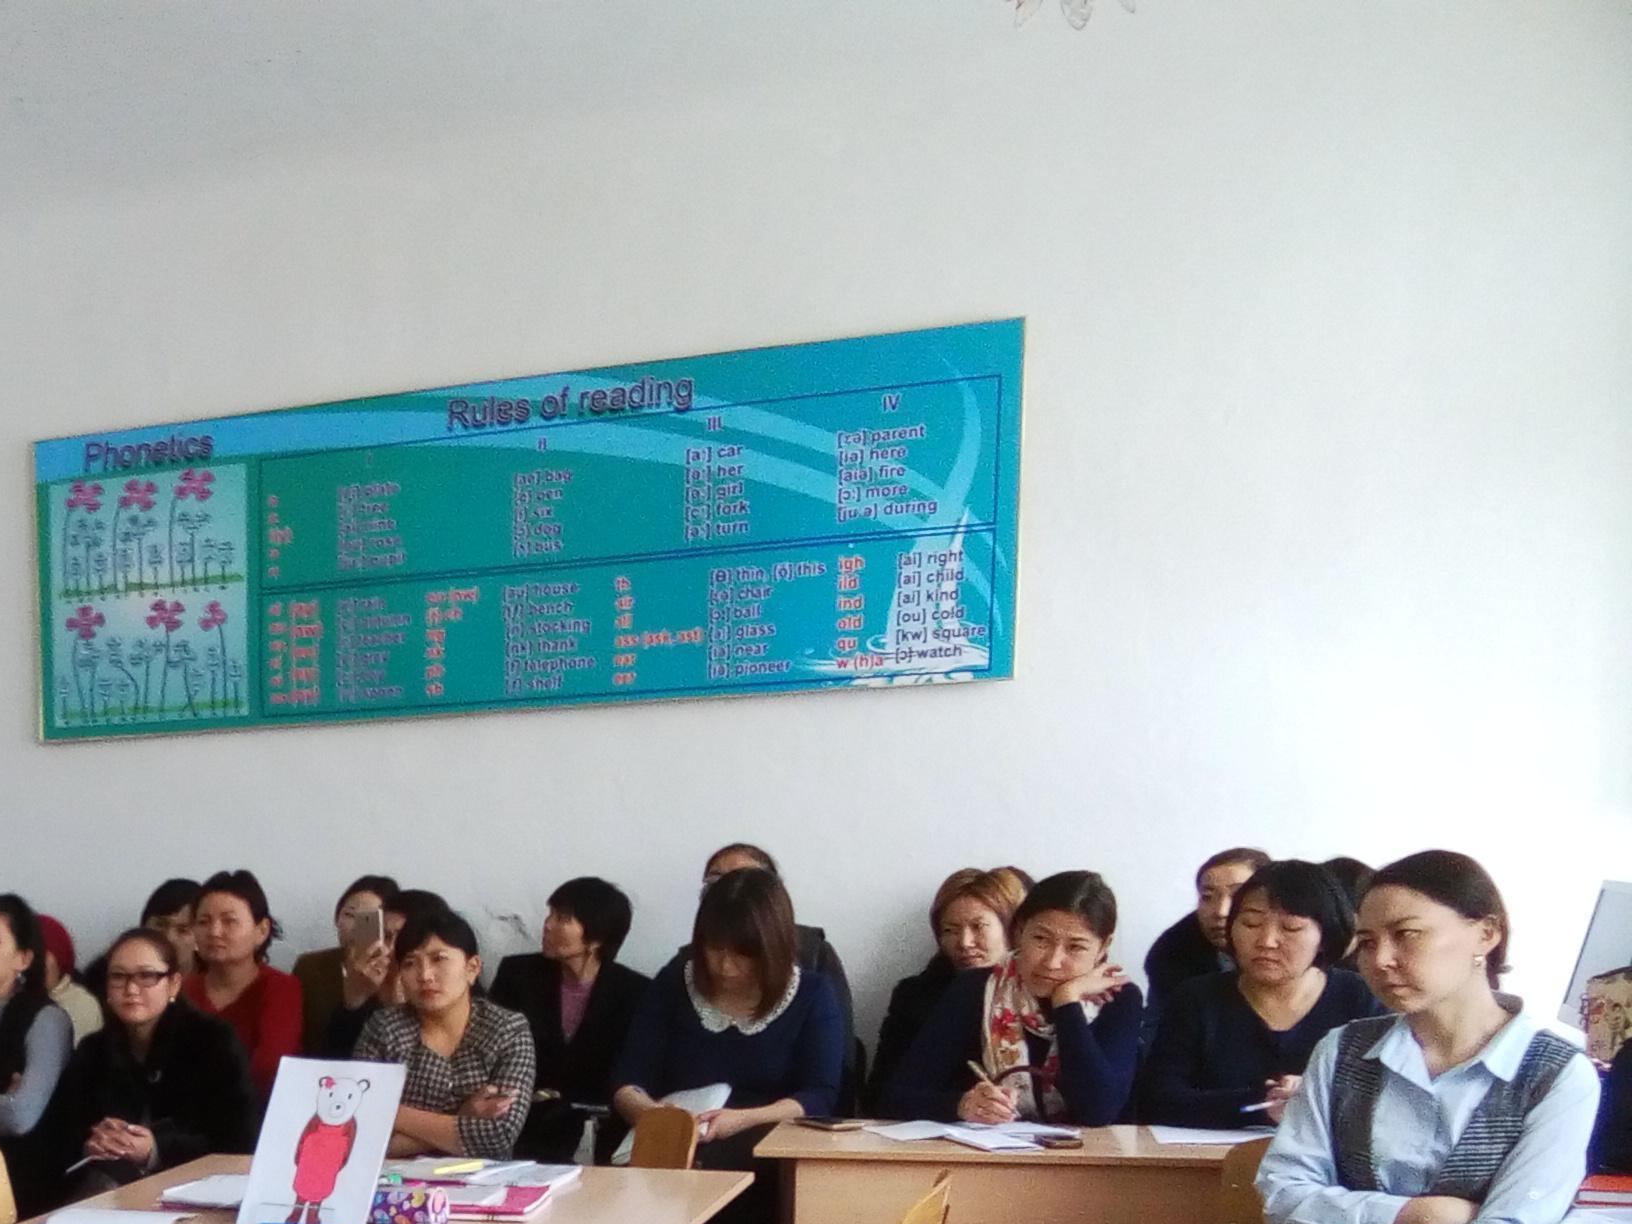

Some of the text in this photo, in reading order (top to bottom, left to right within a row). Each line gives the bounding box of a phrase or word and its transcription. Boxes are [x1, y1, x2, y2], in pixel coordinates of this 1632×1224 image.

[447, 375, 694, 431] Rules of reading
[882, 395, 901, 411] IV
[707, 416, 722, 431] III
[871, 426, 925, 445] parent
[84, 434, 215, 473] Phonetics
[717, 445, 744, 458] car
[870, 447, 906, 460] here
[717, 465, 745, 477] her
[879, 465, 906, 478] fire
[717, 482, 743, 500] girl
[866, 485, 908, 498] more
[717, 501, 749, 515] fork
[883, 501, 937, 515] during
[717, 520, 749, 534] turn
[839, 556, 864, 573] igh
[927, 550, 964, 569] right
[797, 562, 826, 575] this
[838, 575, 858, 589] ild
[927, 569, 964, 584] child
[533, 583, 579, 596] house
[738, 586, 773, 600] chair
[926, 588, 960, 602] kind
[528, 600, 574, 616] bench
[838, 597, 863, 610] ind
[734, 605, 761, 618] ball
[931, 607, 965, 621] cold
[528, 618, 591, 635] stocking
[837, 615, 863, 629] old
[736, 624, 776, 640] glass
[932, 625, 986, 640] square
[538, 636, 577, 652] thank
[735, 643, 768, 656] near
[837, 638, 858, 652] qu
[918, 646, 962, 659] watch
[524, 655, 596, 672] telephone
[735, 660, 792, 676] pioneer
[527, 673, 563, 689] shelf
